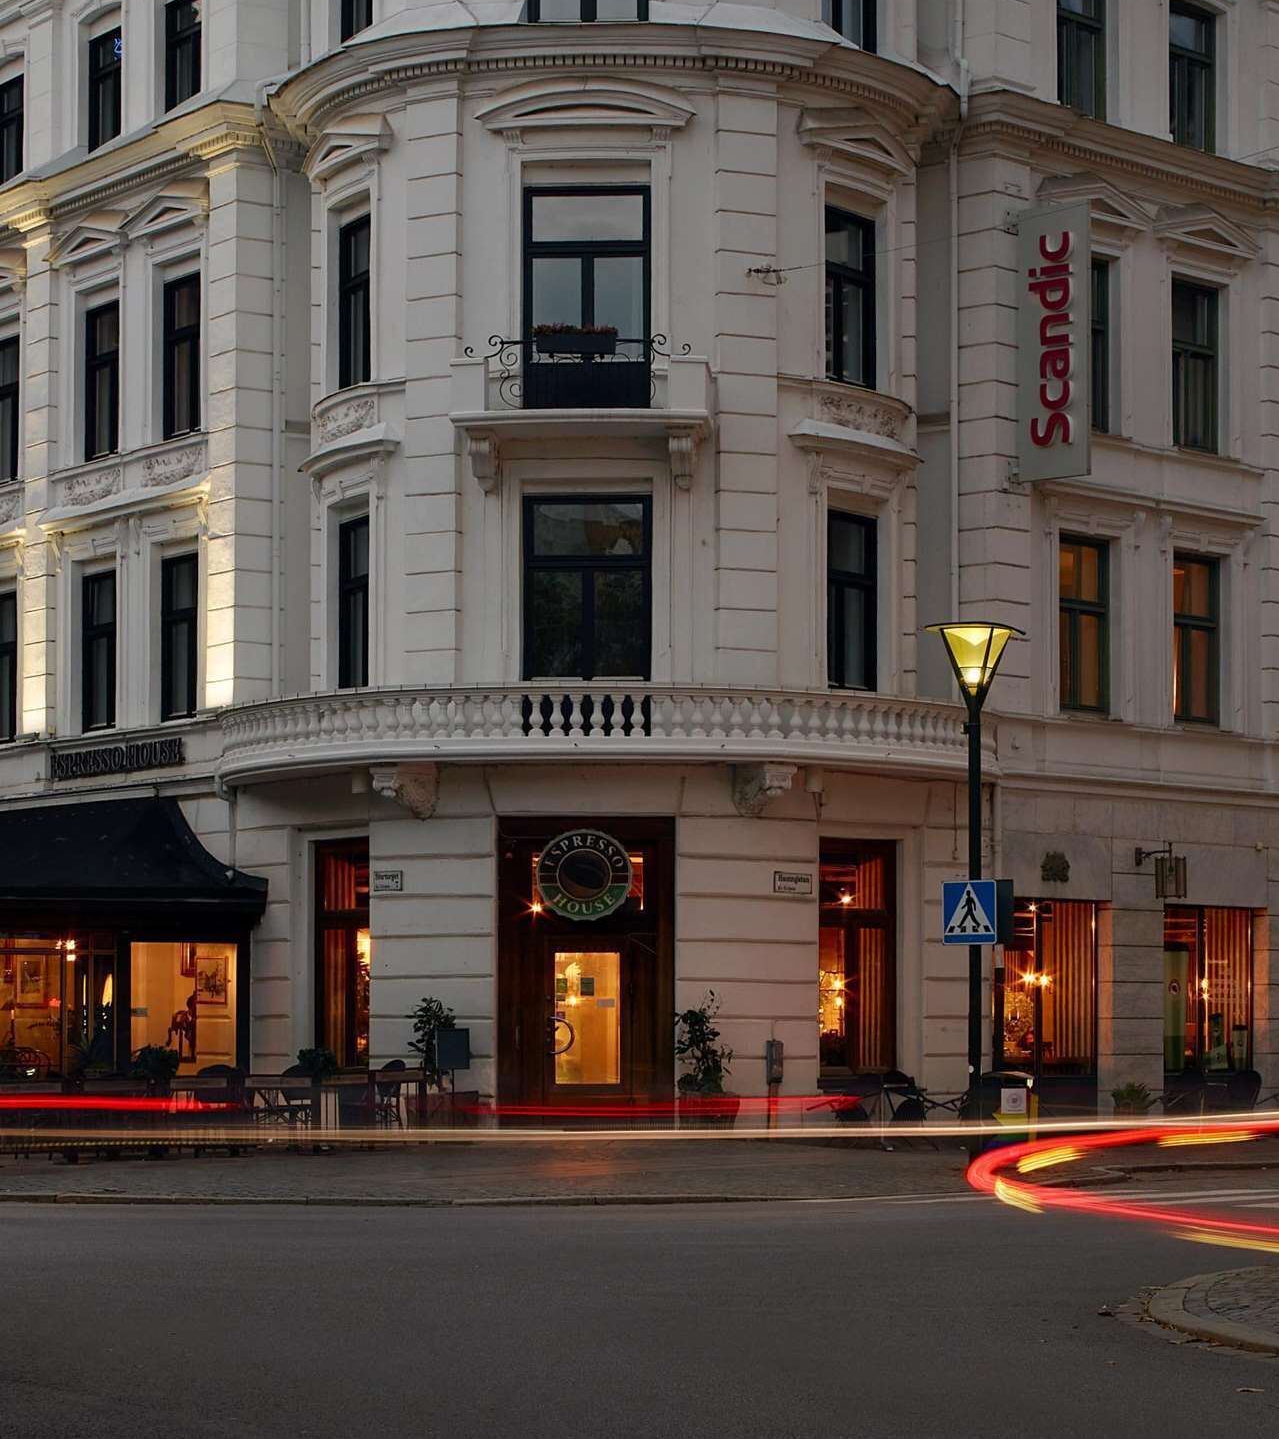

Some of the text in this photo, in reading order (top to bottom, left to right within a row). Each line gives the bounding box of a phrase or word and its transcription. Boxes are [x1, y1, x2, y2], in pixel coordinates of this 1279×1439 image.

[1028, 231, 1071, 447] Scandic
[50, 738, 186, 780] ESPRESSO HOUSE
[544, 835, 624, 867] ESPRESSO
[553, 893, 616, 914] HOUSE
